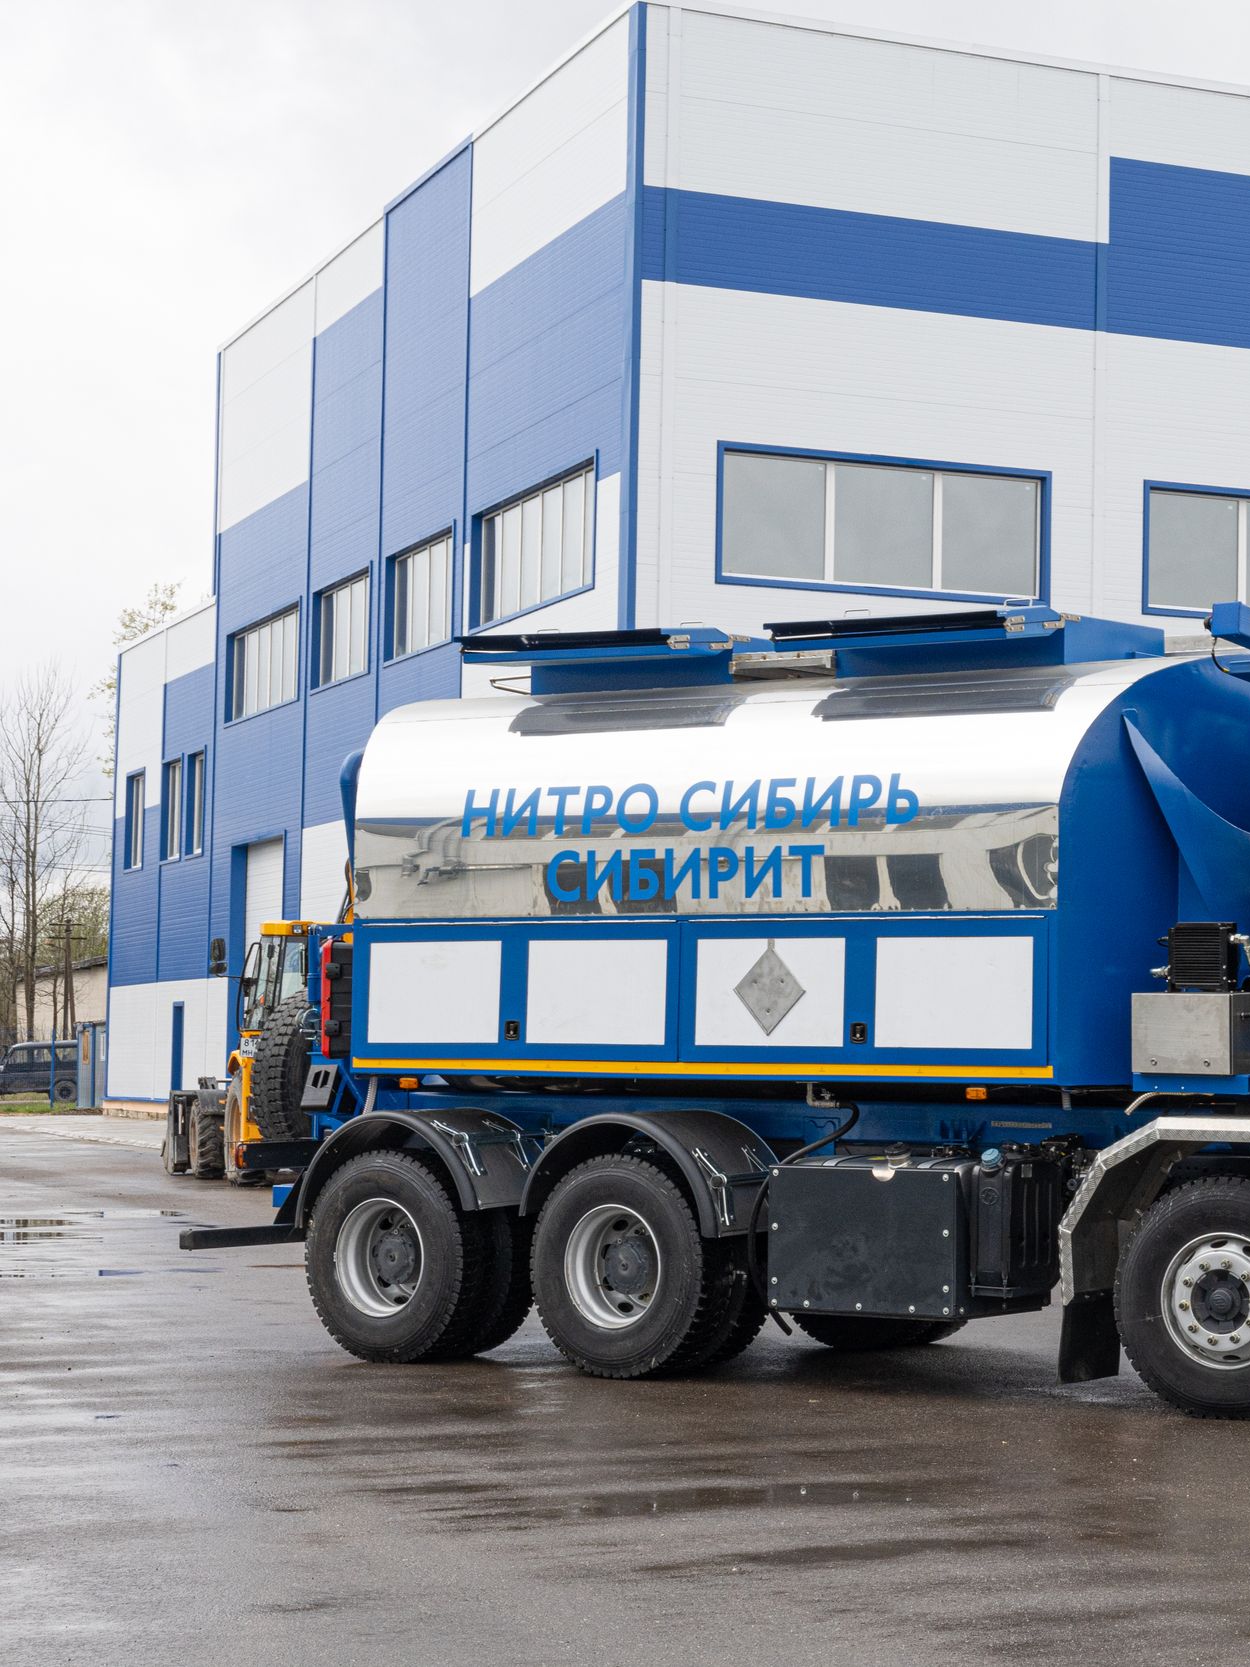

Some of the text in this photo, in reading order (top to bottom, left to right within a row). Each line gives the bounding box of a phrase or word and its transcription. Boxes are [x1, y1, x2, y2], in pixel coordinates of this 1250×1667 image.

[461, 773, 920, 838] НИТРО СИБИРЬ
[546, 844, 825, 902] СИБИРИТ
